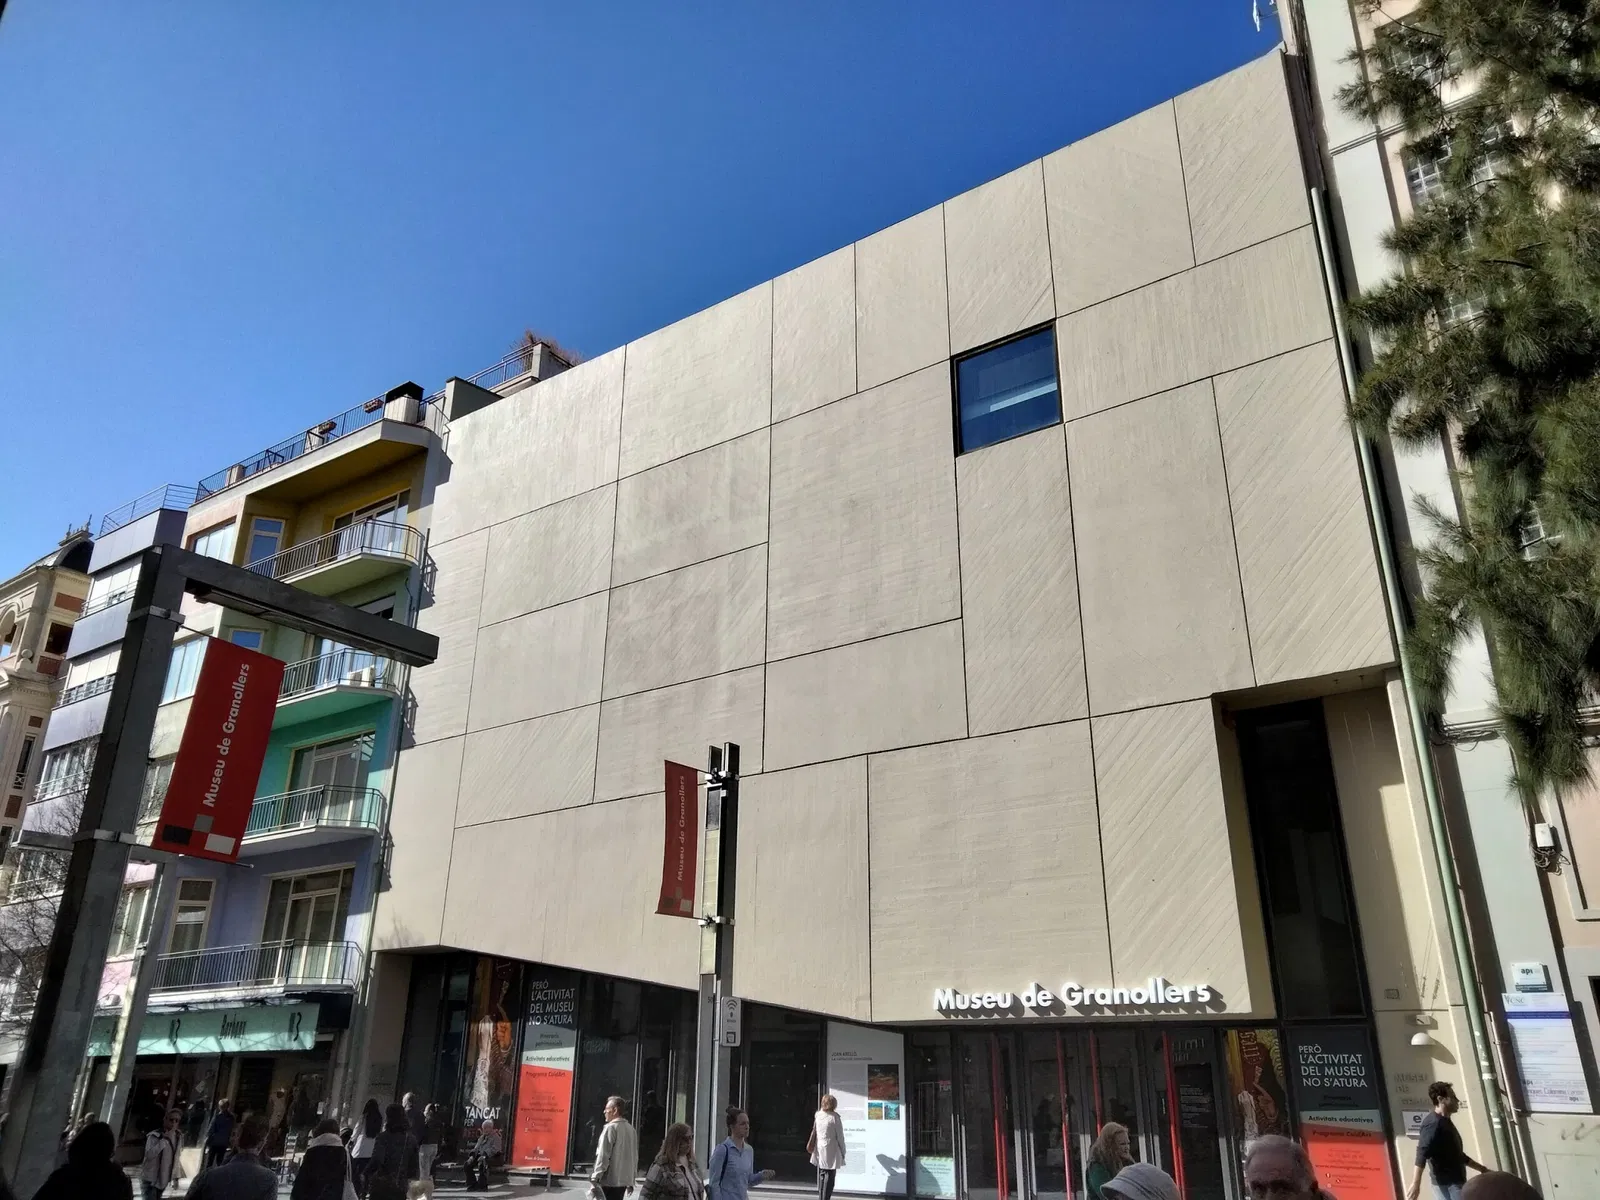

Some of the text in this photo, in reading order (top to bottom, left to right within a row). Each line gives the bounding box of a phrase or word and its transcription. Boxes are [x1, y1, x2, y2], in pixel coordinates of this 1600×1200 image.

[202, 663, 249, 808] Museu de Granollers
[677, 775, 686, 881] Museu de Granollers
[532, 979, 549, 991] PERÒ
[531, 988, 575, 1002] L'ACTIVITAT
[933, 978, 1211, 1011] Museu de Granollers
[530, 1001, 575, 1015] DEL MUSEU
[528, 1015, 573, 1028] NO S'ATURA
[1298, 1044, 1322, 1054] PERÒ
[1299, 1054, 1363, 1065] L'ACTIVITAT
[1301, 1066, 1366, 1077] DEL MUSEU
[1302, 1077, 1368, 1088] NO S'ATURA
[465, 1106, 501, 1120] TANCAT
[464, 1118, 475, 1127] PER
[1338, 1115, 1374, 1124] educatives
[1312, 1130, 1345, 1138] Programa
